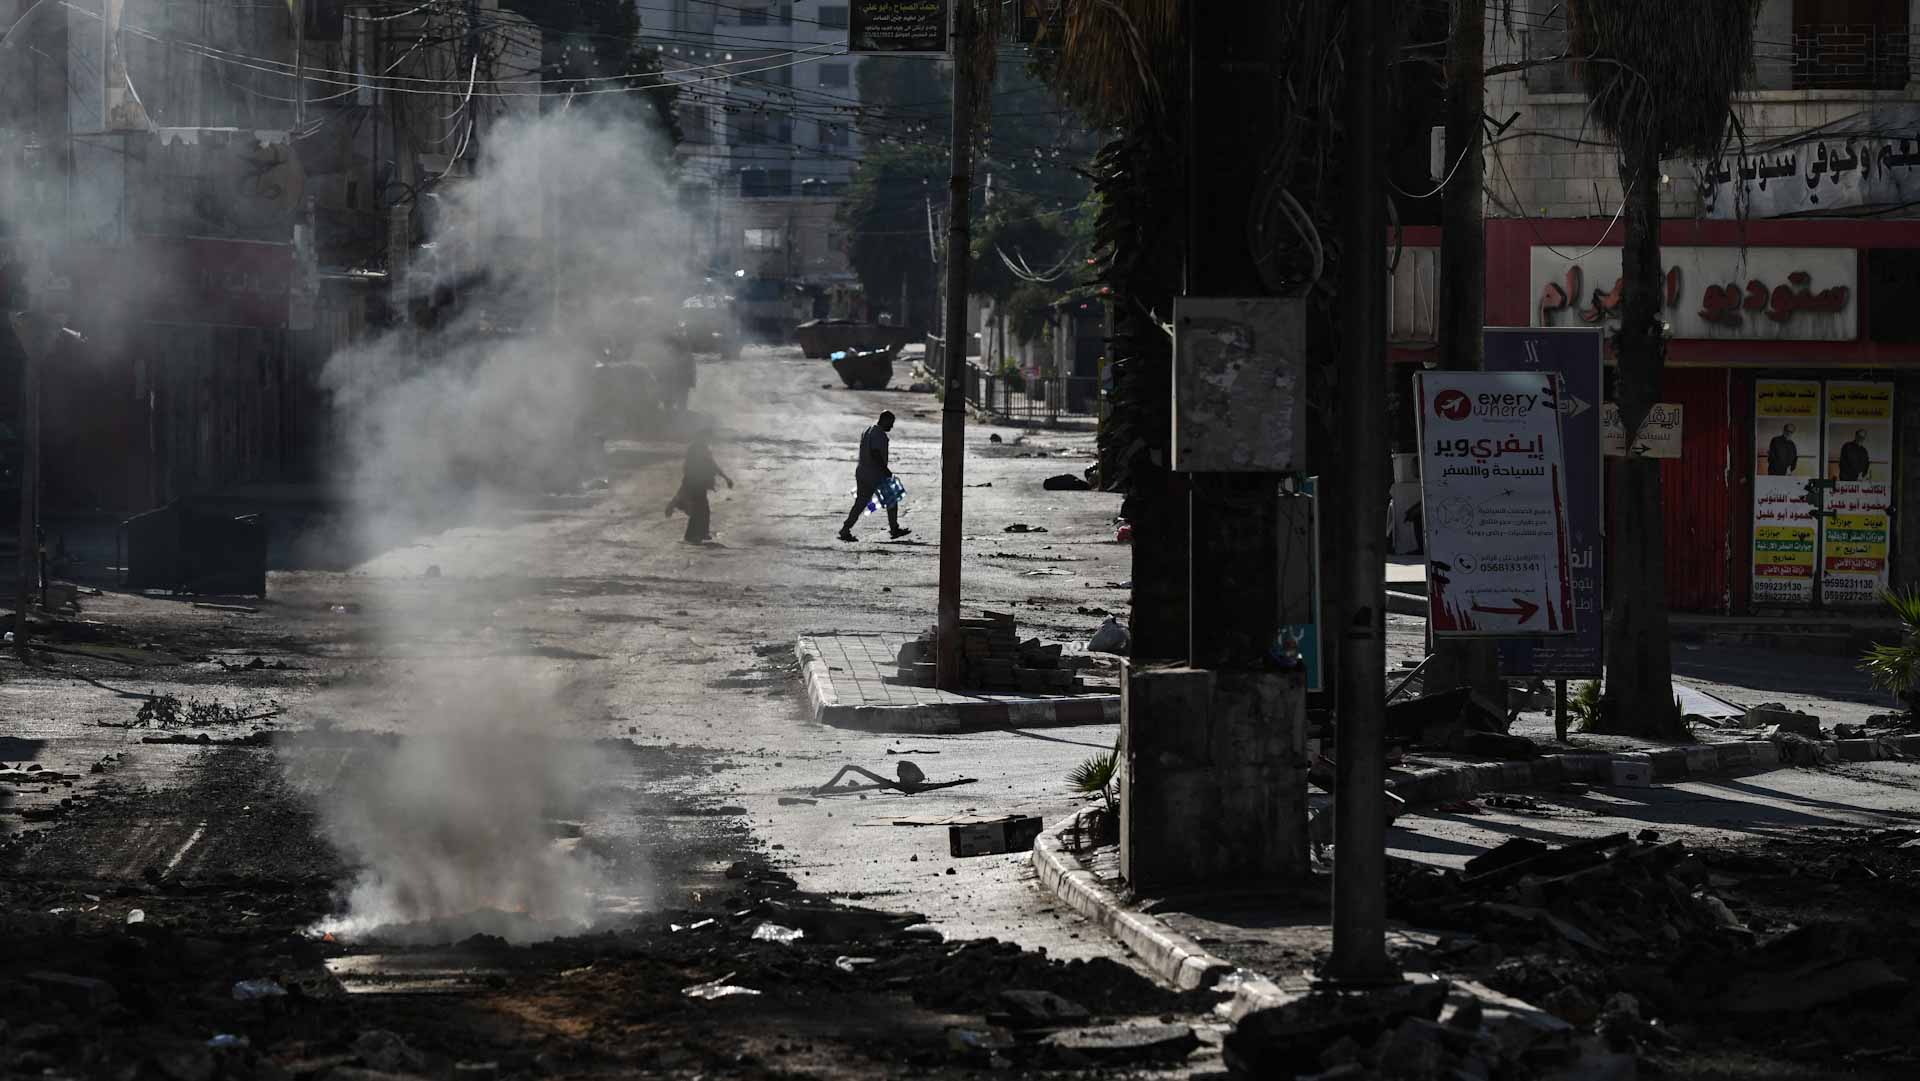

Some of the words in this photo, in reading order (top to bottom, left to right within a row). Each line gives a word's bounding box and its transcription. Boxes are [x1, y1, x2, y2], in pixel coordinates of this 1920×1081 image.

[1697, 271, 1850, 327] ستوديو
[1473, 401, 1528, 417] where
[1478, 393, 1537, 412] every
[1492, 464, 1545, 479] للسياحة
[1480, 563, 1540, 573] 0568133341
